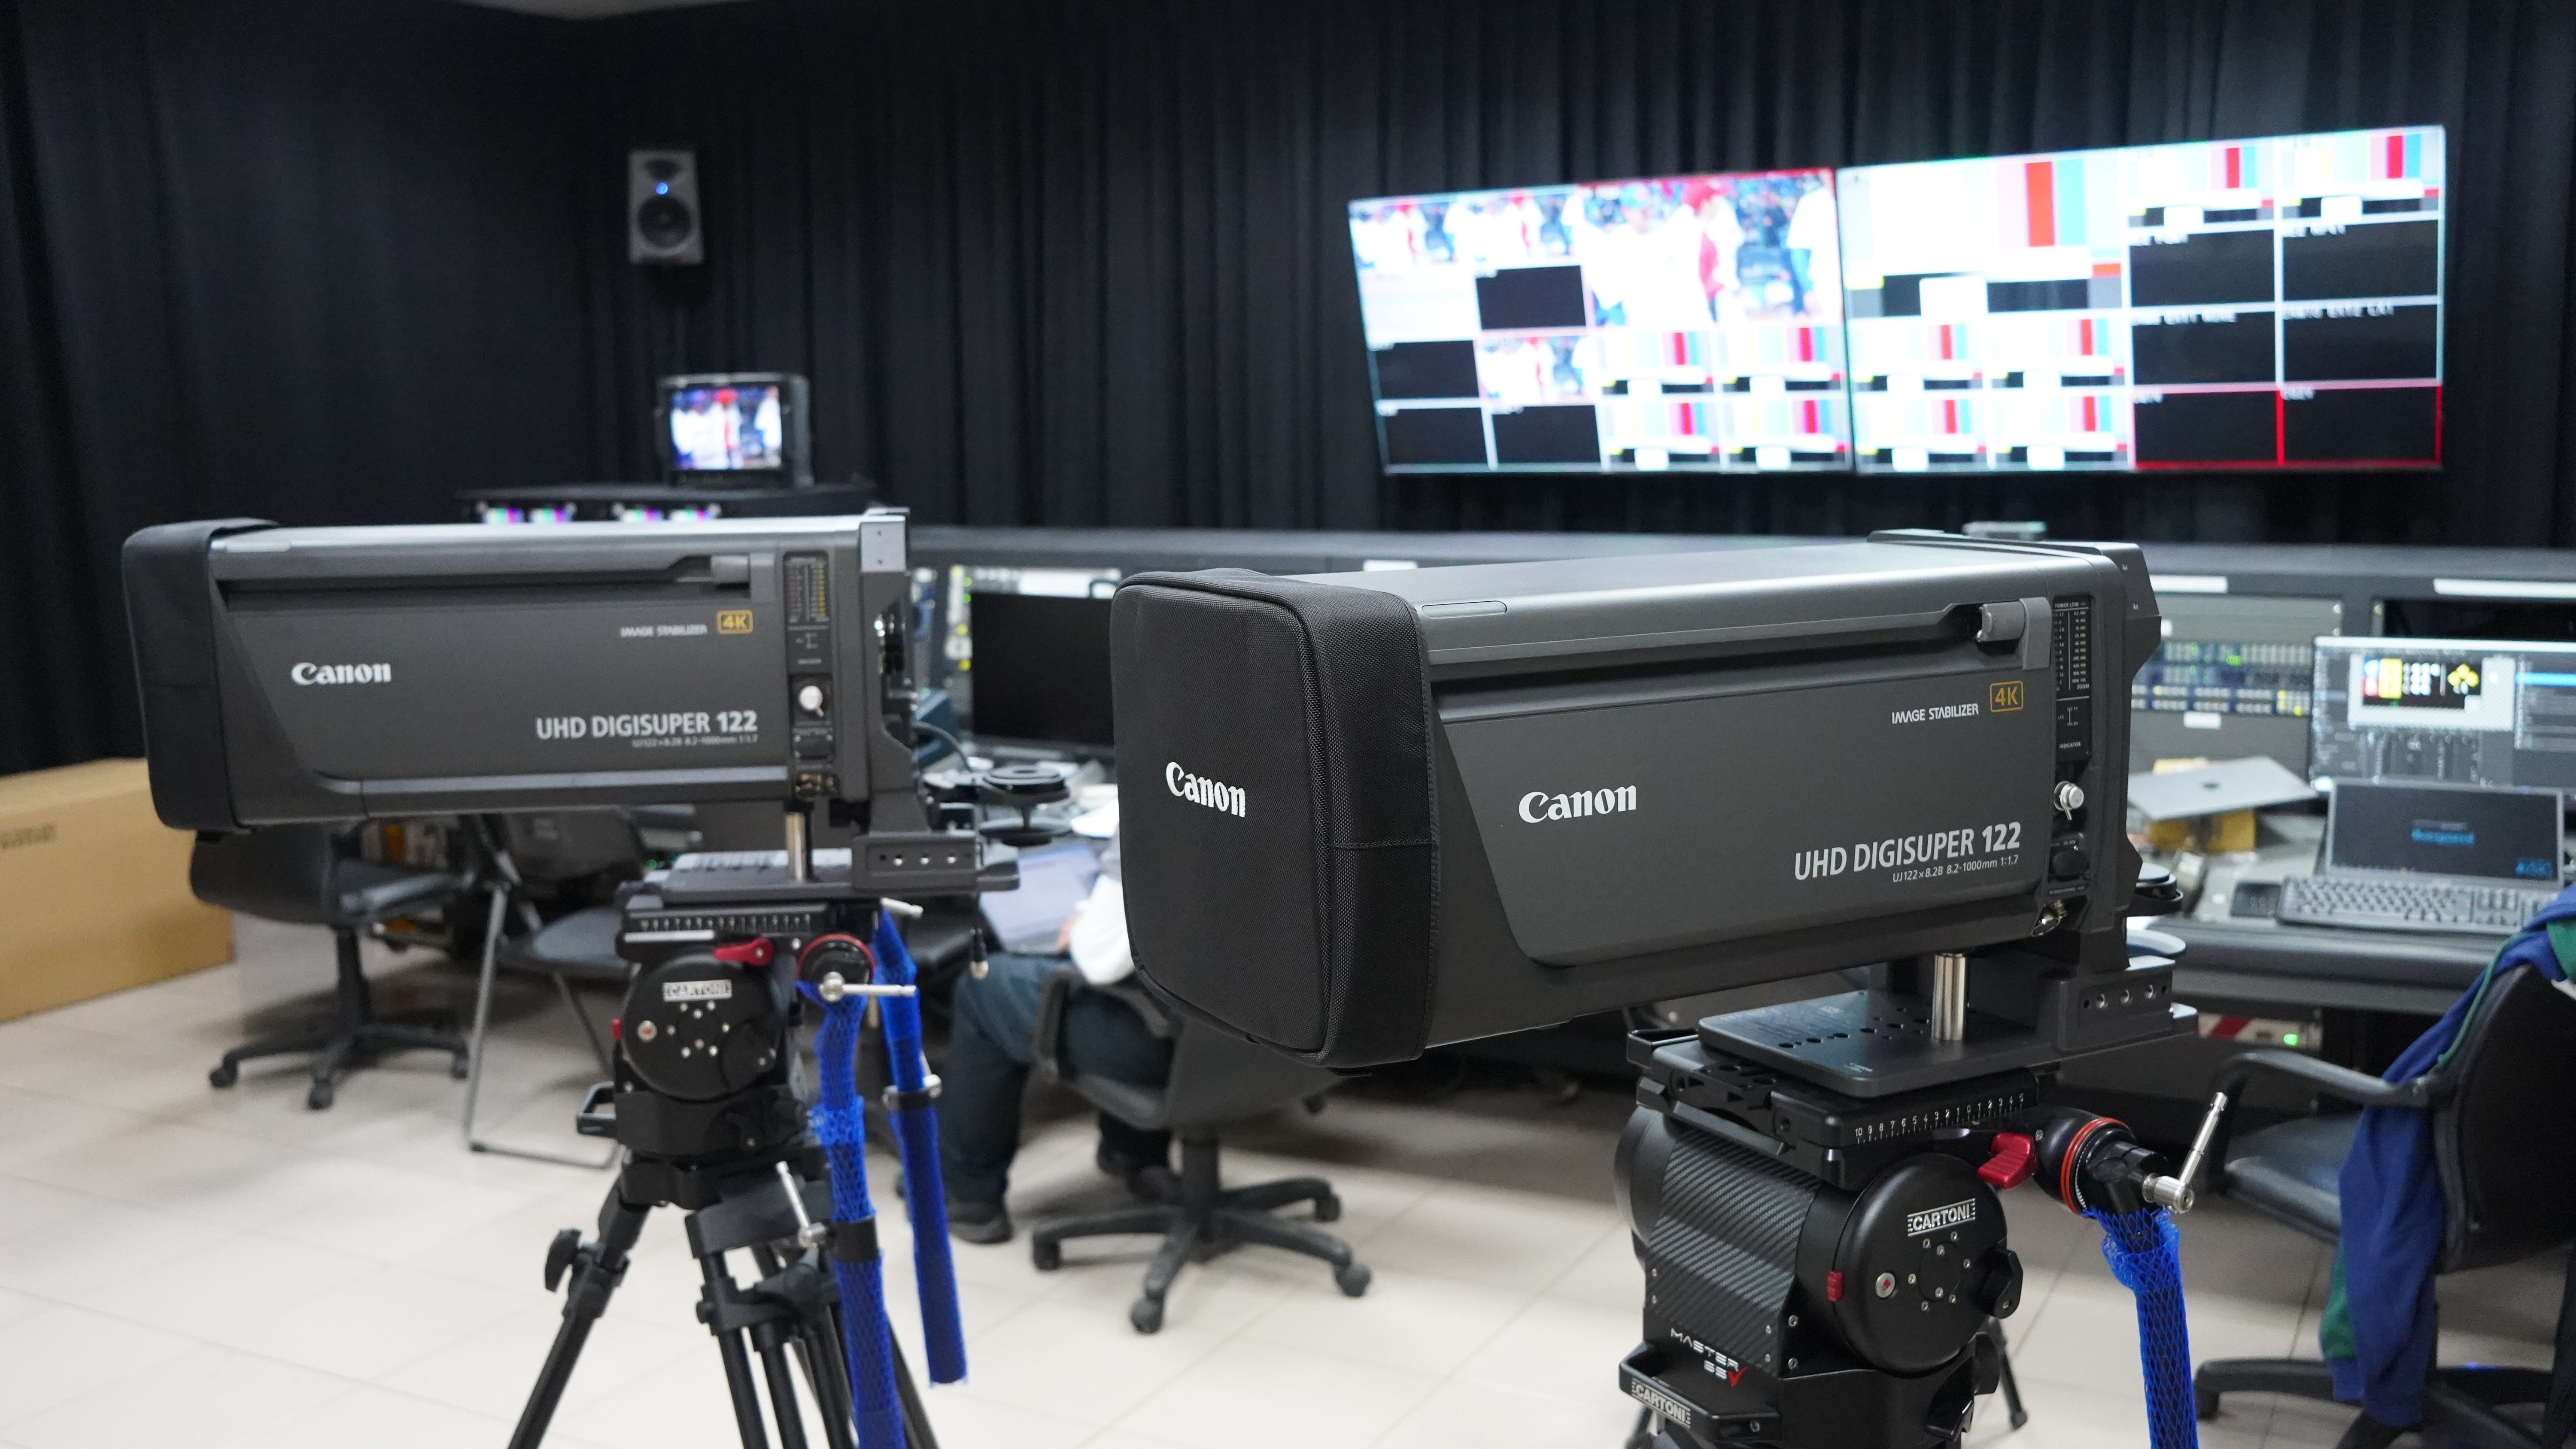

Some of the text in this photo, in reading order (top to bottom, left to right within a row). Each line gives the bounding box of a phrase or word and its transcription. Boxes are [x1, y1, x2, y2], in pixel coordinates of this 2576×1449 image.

[723, 614, 747, 628] 4K
[291, 662, 392, 685] Canon
[1995, 686, 2018, 706] 4K
[536, 710, 758, 740] UHD DIGISUPER 122
[1892, 703, 1979, 724] IMAGE STABILIZER
[1166, 762, 1245, 818] Canon
[1519, 785, 1637, 823] Canon
[1794, 821, 2021, 880] UHD DIGISUPER 122
[1947, 859, 1997, 875] 8.2-1000mm
[2000, 854, 2019, 867] 1:1.7
[1855, 1128, 1862, 1137] 10
[1868, 1125, 1872, 1134] 9
[1879, 1123, 1883, 1131] 8
[1890, 1120, 1895, 1129] 7
[1902, 1118, 1906, 1127] 6
[1913, 1116, 1917, 1125] 5
[1935, 1111, 1939, 1120] 3
[1945, 1109, 1950, 1118] 2
[1967, 1104, 1971, 1113] 0
[1988, 1100, 1993, 1109] 2
[1999, 1097, 2003, 1106] 3
[1912, 1203, 1970, 1231] CARTONI
[1671, 1328, 1739, 1372] MASTER
[1636, 1385, 1685, 1422] CARTONI
